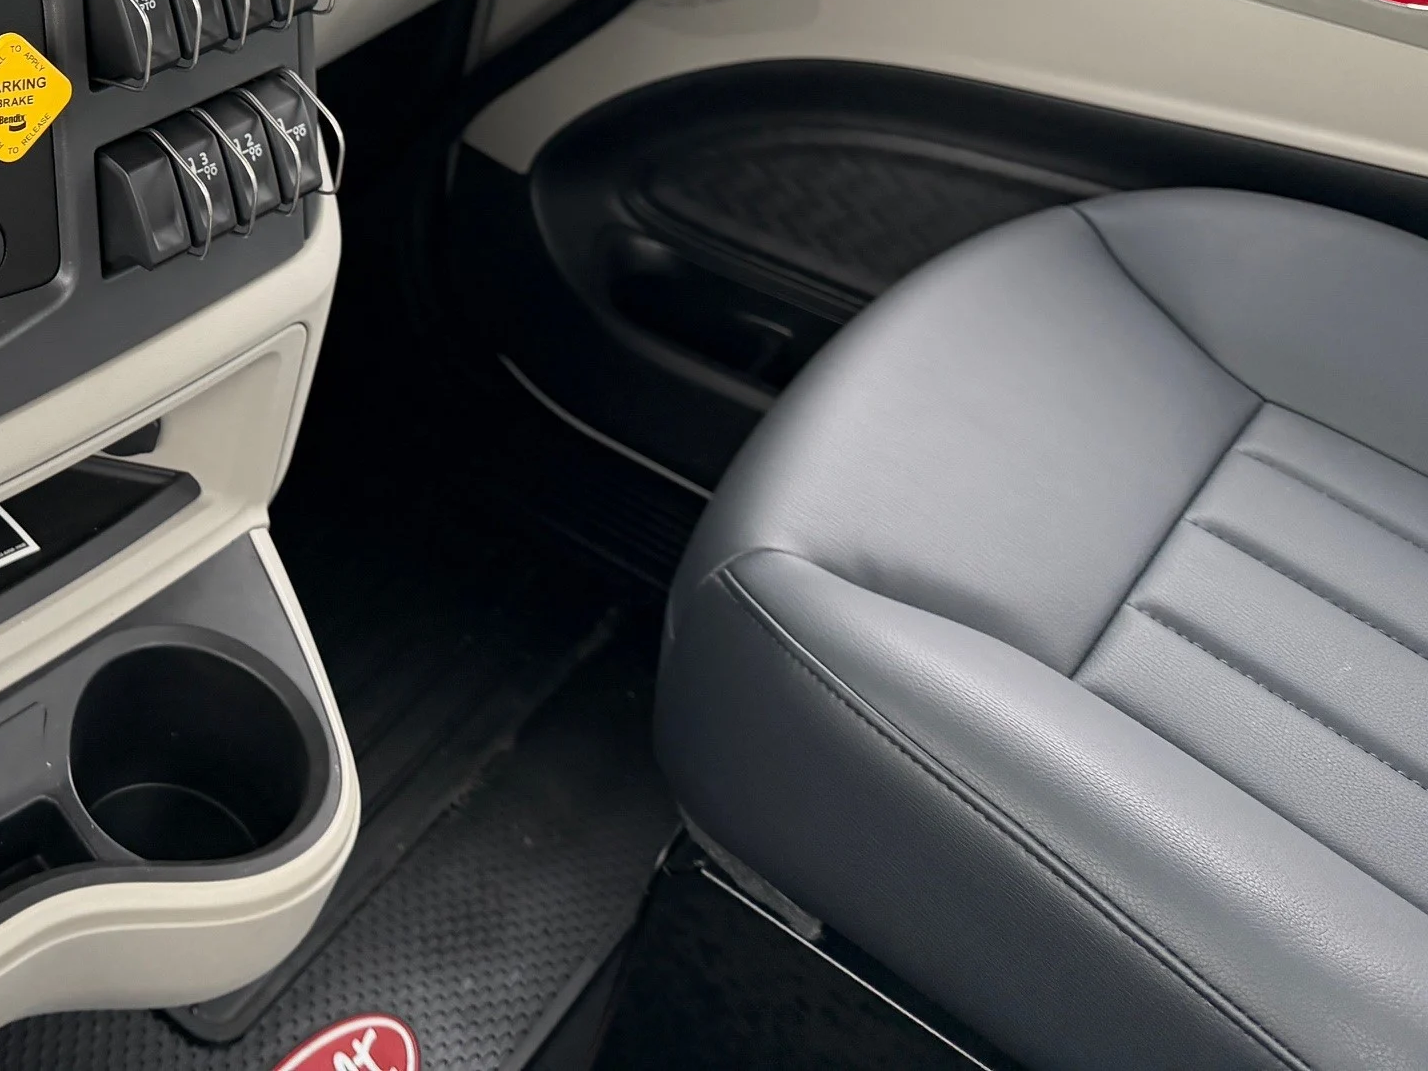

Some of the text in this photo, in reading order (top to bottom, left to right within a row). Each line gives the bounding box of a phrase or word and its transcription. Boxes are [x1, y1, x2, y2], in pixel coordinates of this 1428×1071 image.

[10, 45, 22, 54] TO
[23, 51, 46, 72] APPLY
[8, 146, 19, 155] TO
[21, 113, 52, 146] RELEASE
